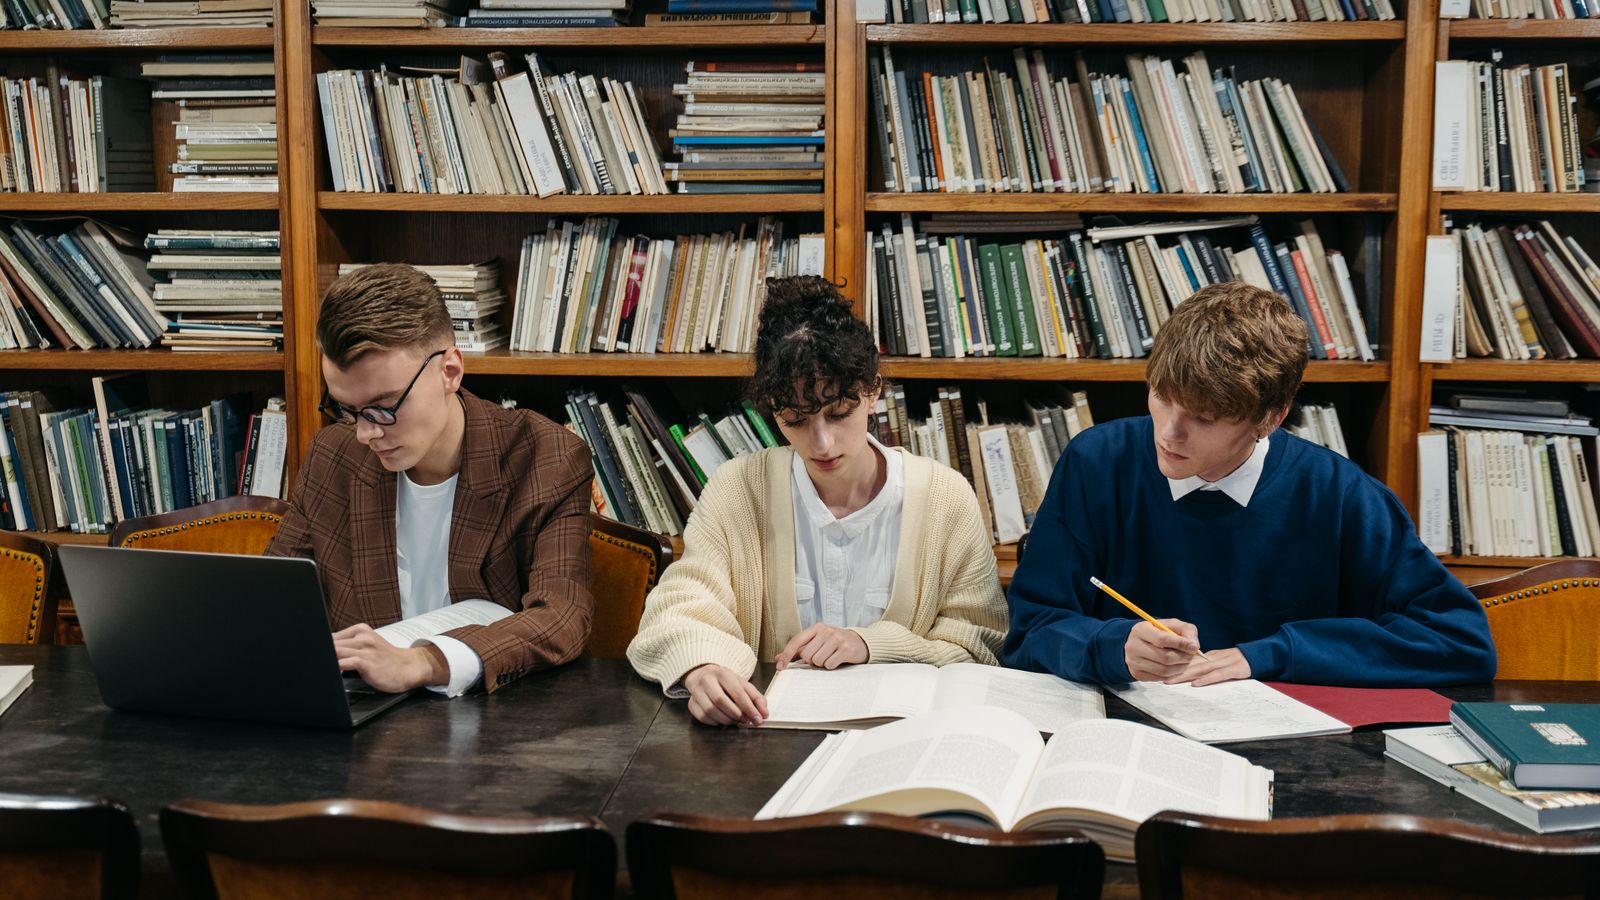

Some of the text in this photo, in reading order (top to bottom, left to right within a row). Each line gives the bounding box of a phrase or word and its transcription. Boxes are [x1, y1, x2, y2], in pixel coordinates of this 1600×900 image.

[720, 13, 775, 21] ПОРТИВНЫЕ
[996, 311, 1006, 344] КОНСТРУКЦ
[1017, 310, 1028, 344] КОНСТРУКЦ
